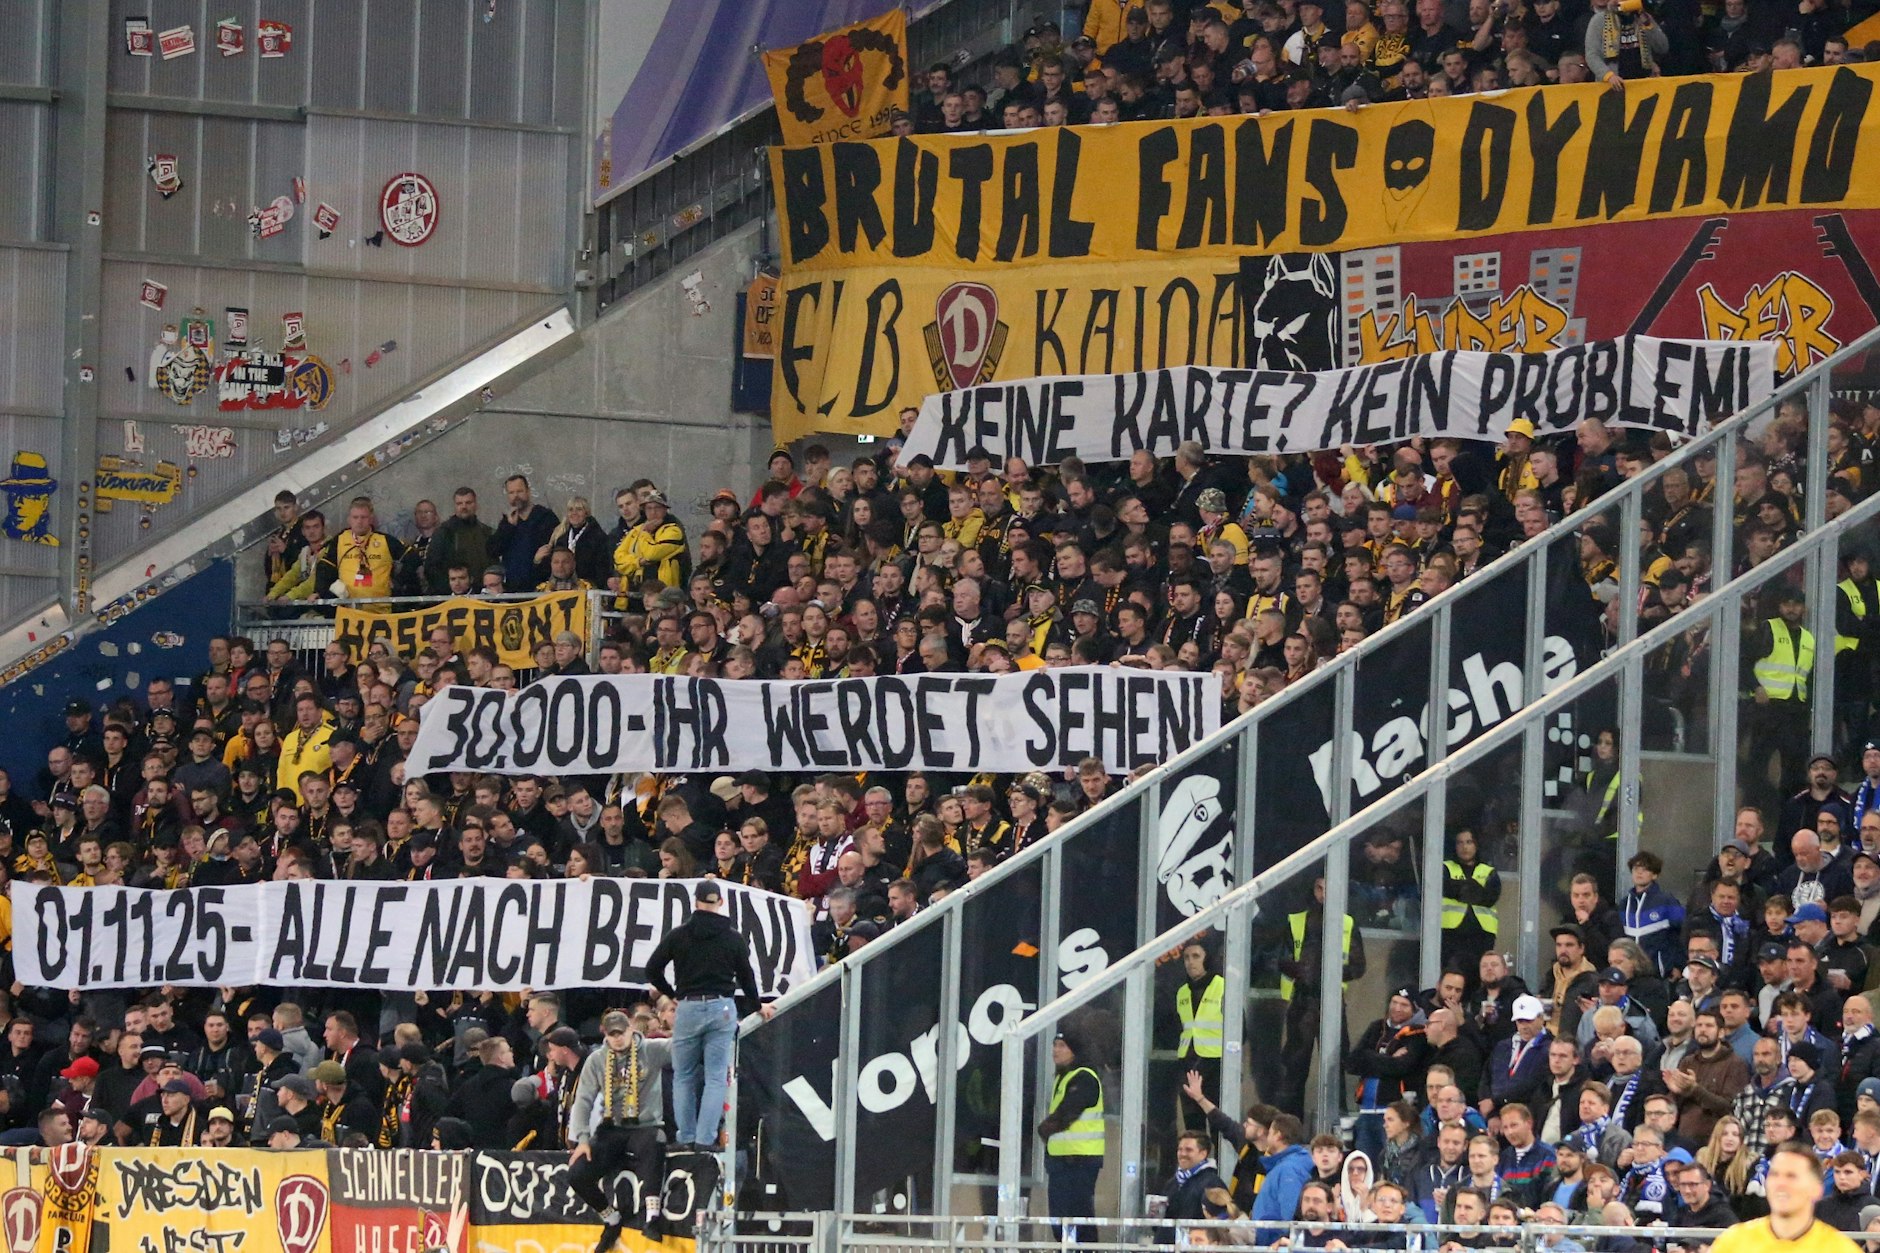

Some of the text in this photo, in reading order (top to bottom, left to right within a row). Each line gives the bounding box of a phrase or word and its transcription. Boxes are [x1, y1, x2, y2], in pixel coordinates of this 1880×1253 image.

[782, 67, 1874, 264] BRUTAL FANS DYNAMO
[1697, 271, 1842, 378] DER
[932, 381, 1083, 466] KEINE
[1111, 366, 1317, 458] KARTE?
[1319, 349, 1455, 449] KEIN
[761, 676, 997, 768] WERDET
[1308, 635, 1578, 818] Rache
[35, 886, 252, 985] 01.11.25-
[261, 880, 408, 985] ALLE
[407, 880, 570, 986] NACH
[115, 1159, 262, 1218] DRESDEN
[340, 1147, 463, 1205] SCHNELLER
